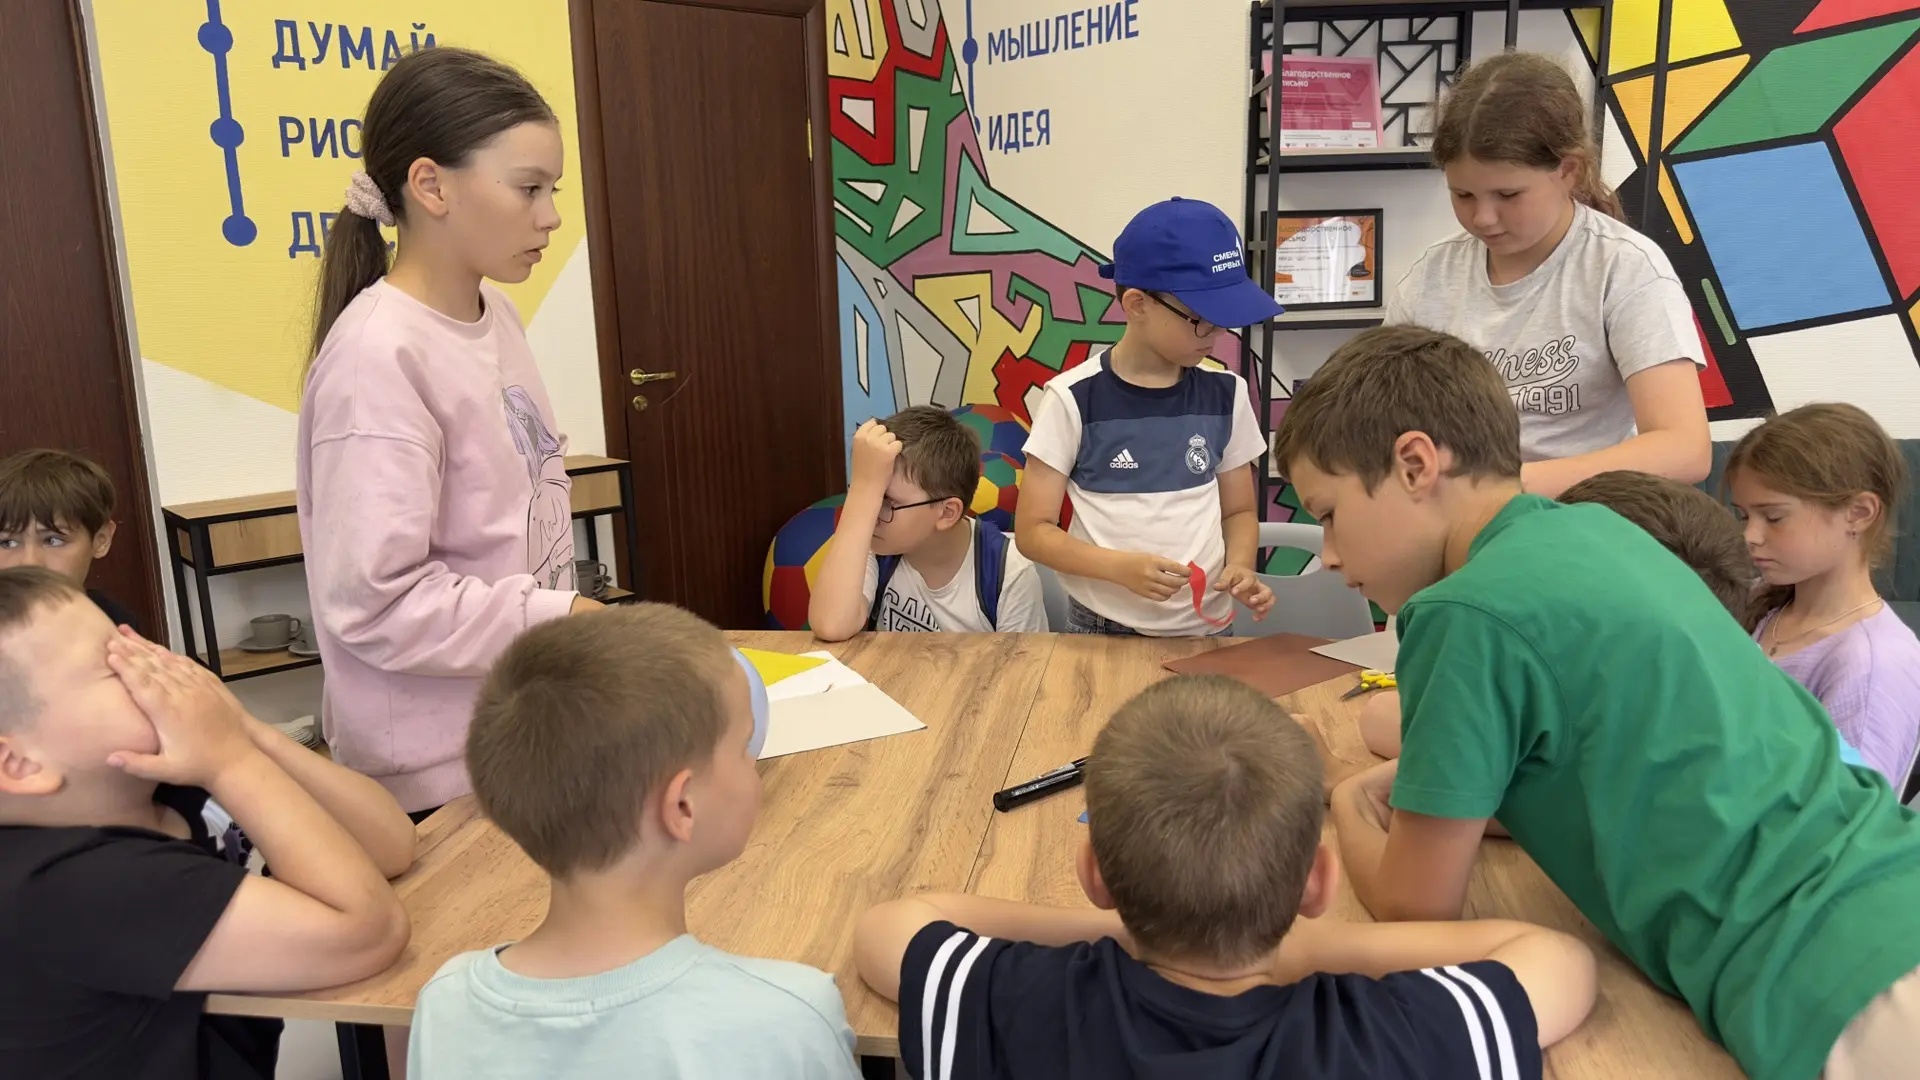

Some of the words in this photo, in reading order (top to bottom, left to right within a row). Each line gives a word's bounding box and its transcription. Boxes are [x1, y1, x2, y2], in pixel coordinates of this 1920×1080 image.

[988, 0, 1139, 65] МЫШЛЕНИЕ
[278, 115, 364, 158] РИС
[988, 109, 1050, 155] ИДЕЯ
[1212, 260, 1241, 273] ПЕРВЫХ
[1213, 250, 1239, 262] СМЕНЫ
[1516, 384, 1581, 416] 1991
[1109, 460, 1138, 469] adidas
